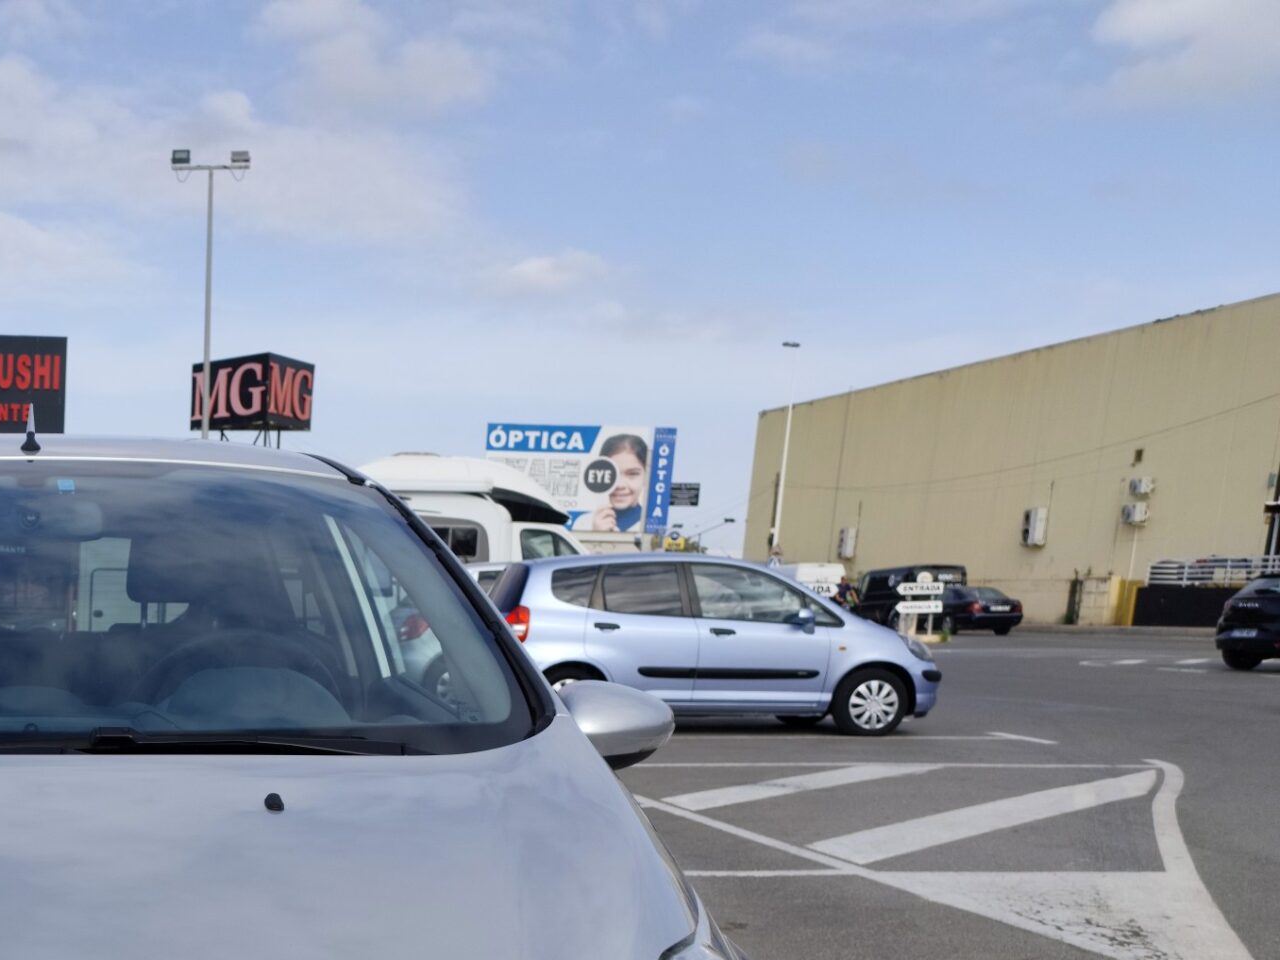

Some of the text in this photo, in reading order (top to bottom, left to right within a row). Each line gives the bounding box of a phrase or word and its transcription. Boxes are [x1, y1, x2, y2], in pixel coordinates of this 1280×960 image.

[191, 362, 266, 421] MG
[268, 361, 312, 421] MG
[489, 426, 584, 450] ÓPTICA
[588, 469, 612, 483] EYE
[903, 584, 940, 592] ENTRADA
